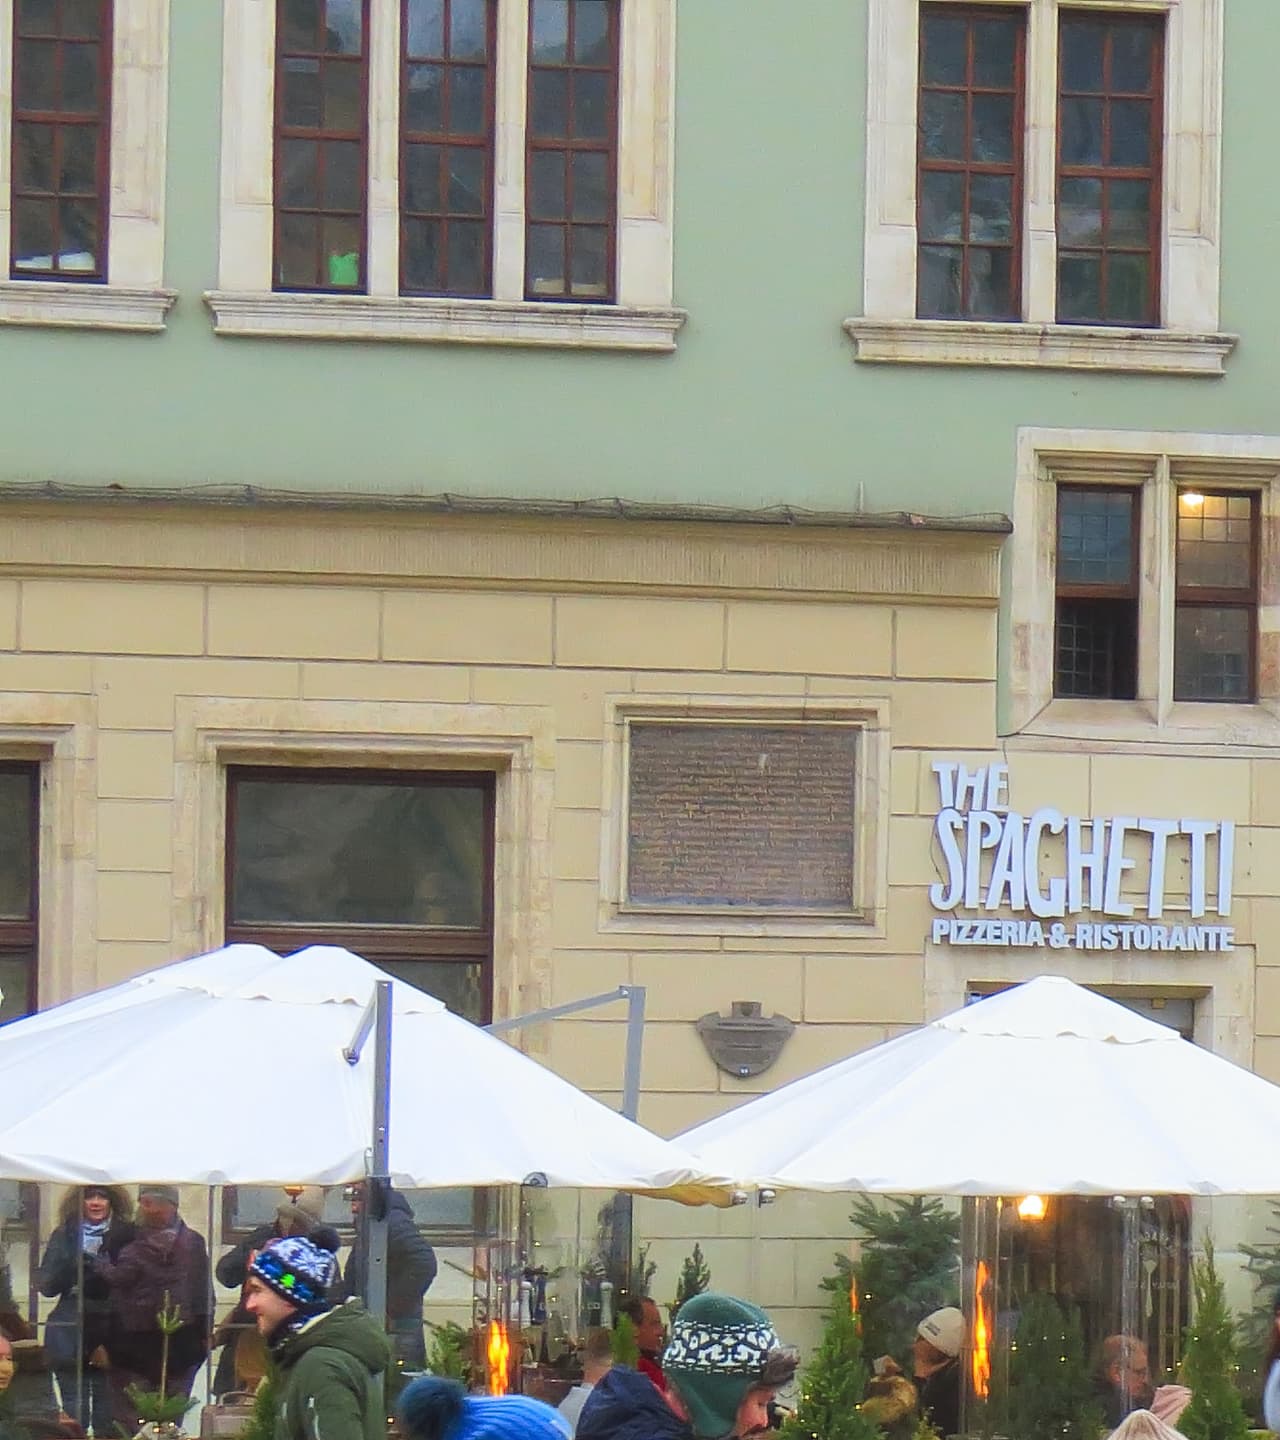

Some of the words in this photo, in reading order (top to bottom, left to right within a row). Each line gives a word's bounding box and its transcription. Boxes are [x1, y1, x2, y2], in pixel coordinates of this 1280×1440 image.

[931, 760, 1008, 812] THE
[929, 808, 1236, 918] SPAGHETTI
[932, 918, 1045, 947] PIZZERIA
[1050, 922, 1070, 949] &
[1076, 923, 1235, 951] RISTORANTE
